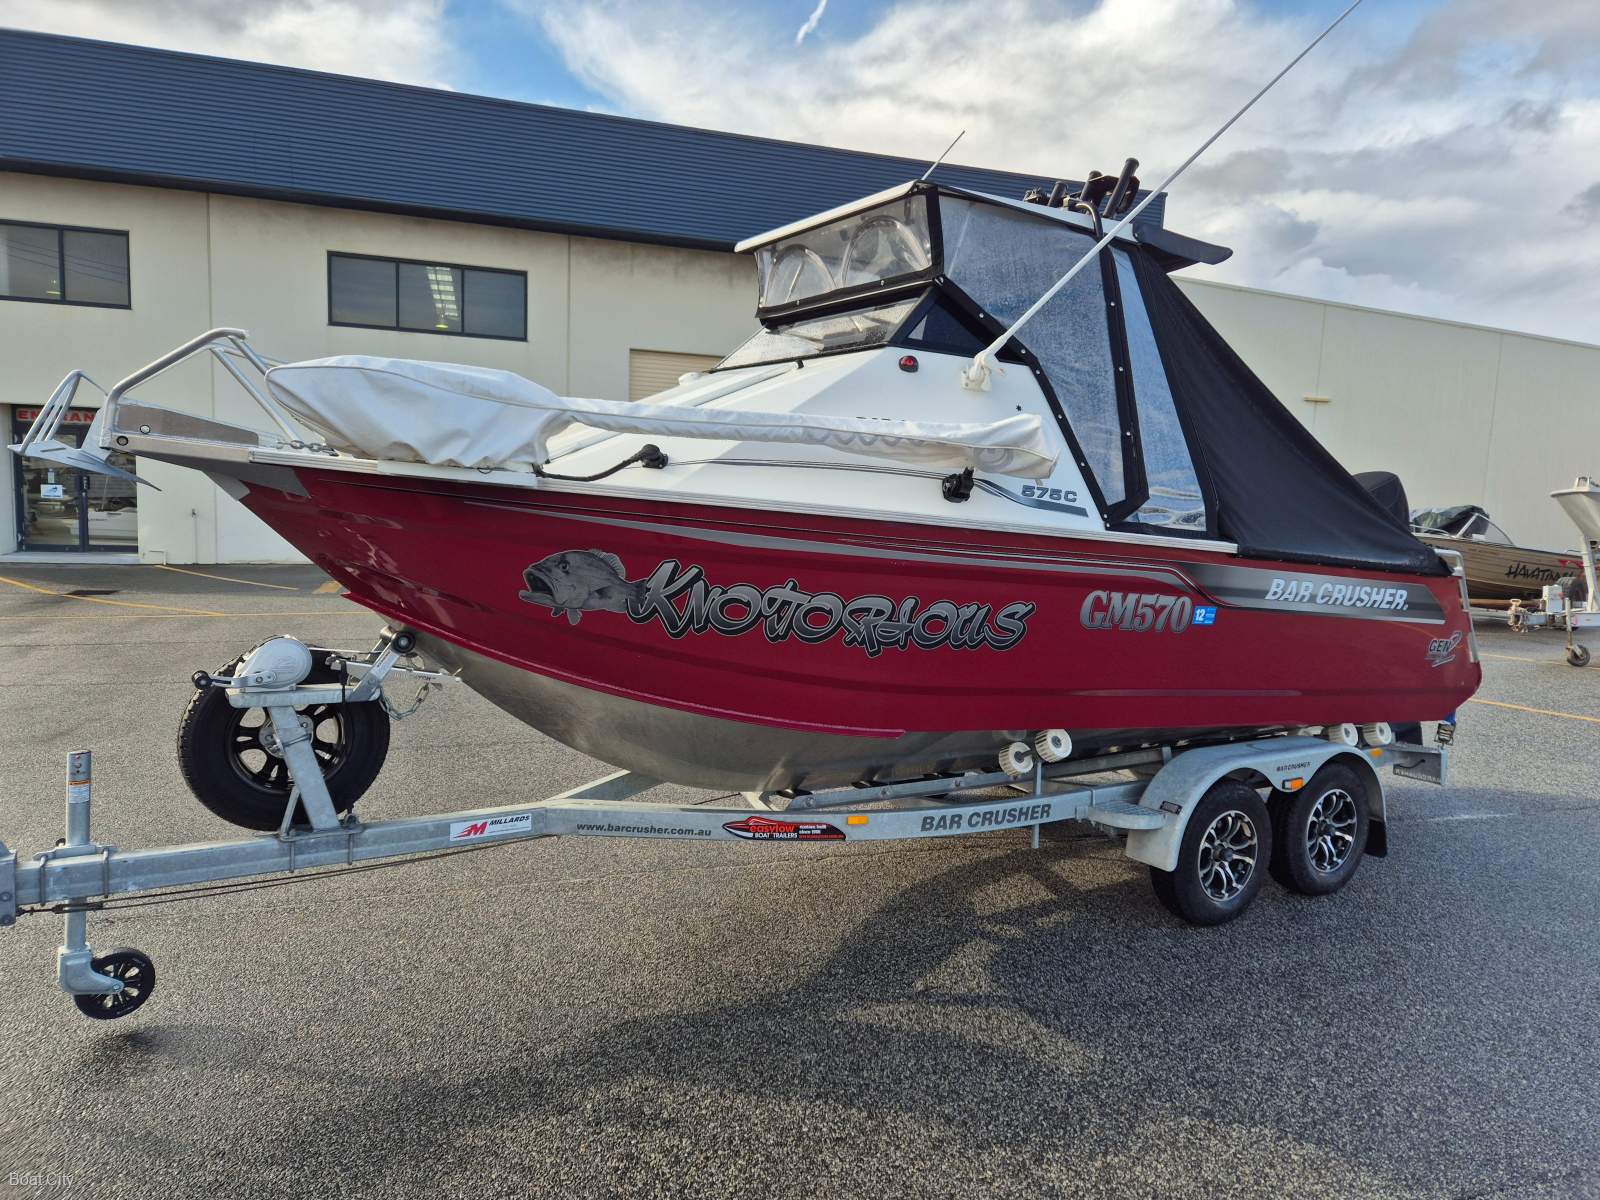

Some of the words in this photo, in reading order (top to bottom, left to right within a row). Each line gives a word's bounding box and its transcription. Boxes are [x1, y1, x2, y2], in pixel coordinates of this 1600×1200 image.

[1021, 484, 1078, 503] 575C
[1265, 578, 1314, 602] BAR
[1080, 590, 1193, 634] GM570
[489, 815, 530, 826] MILLARDS
[920, 813, 963, 832] BAR
[967, 804, 1052, 828] CRUSHER
[576, 822, 712, 837] www.barcrusher.com.au
